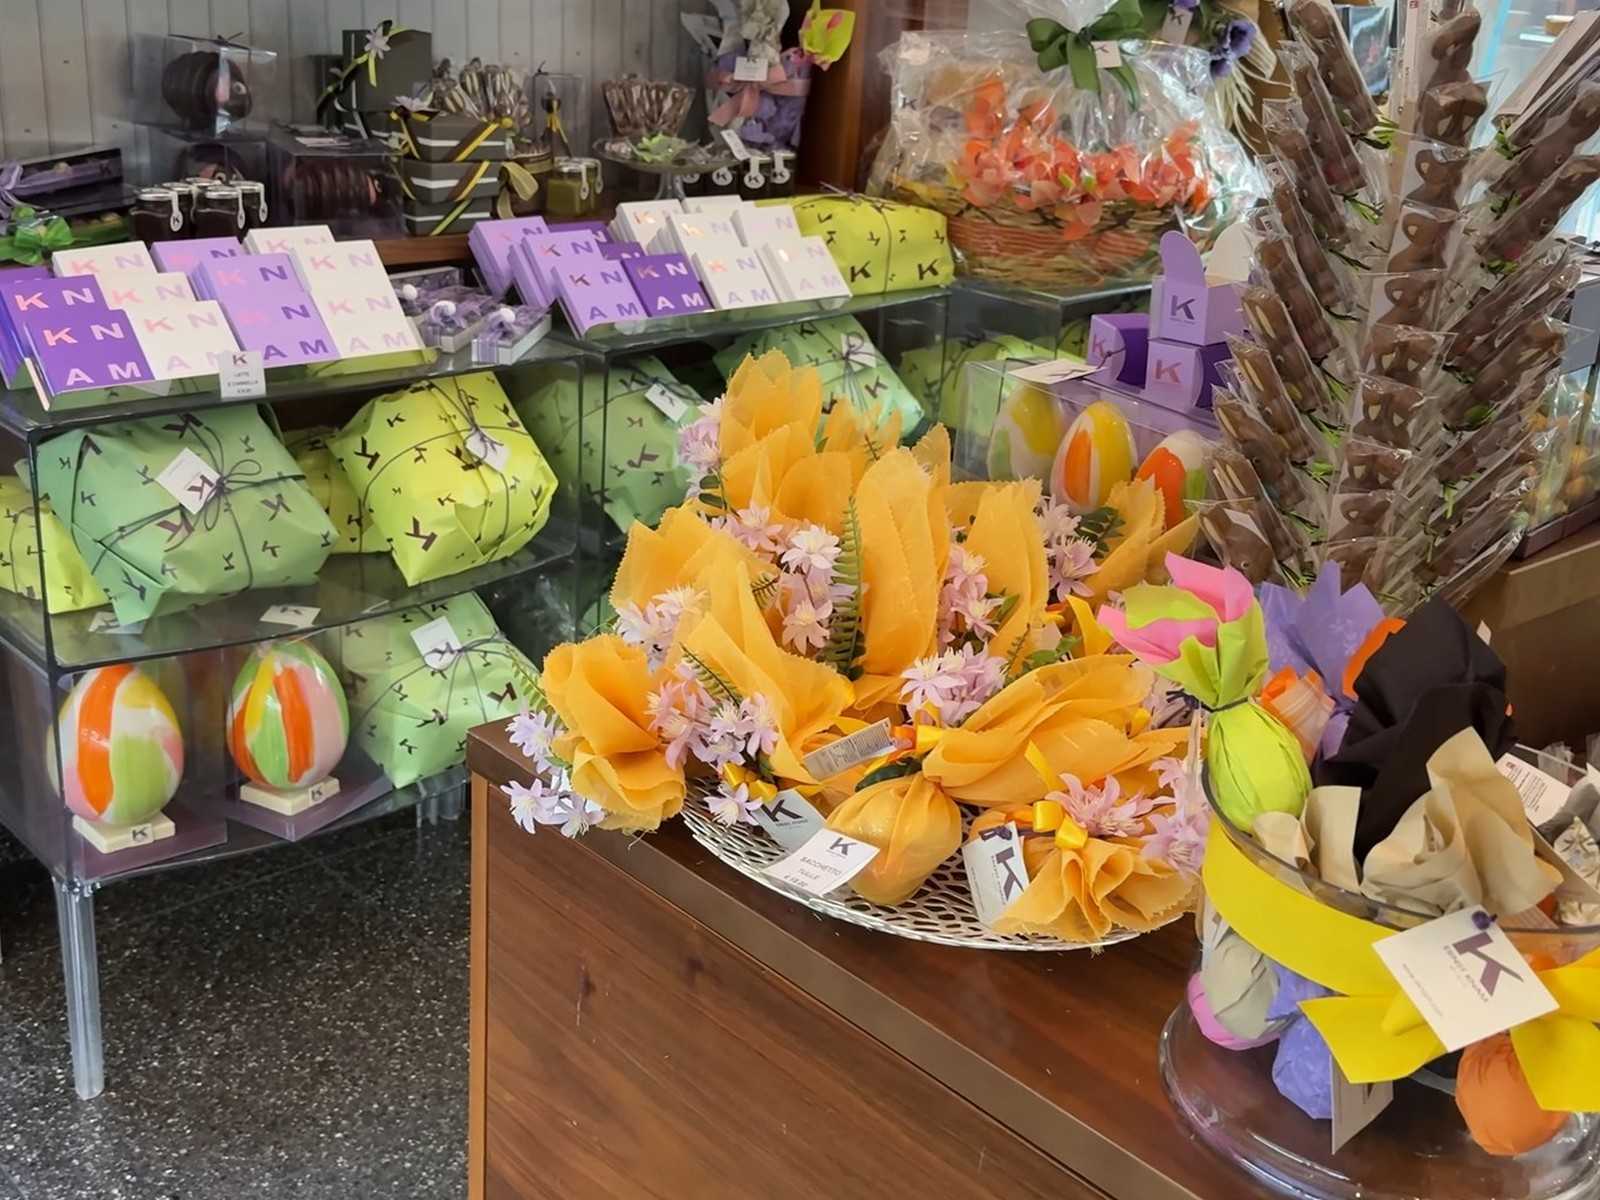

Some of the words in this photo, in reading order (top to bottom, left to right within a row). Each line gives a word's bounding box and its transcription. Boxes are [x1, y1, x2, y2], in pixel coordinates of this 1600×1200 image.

[902, 97, 918, 111] K
[851, 260, 872, 283] K
[917, 258, 940, 281] K
[1171, 295, 1196, 320] K
[232, 354, 248, 366] K
[1155, 359, 1183, 384] K
[865, 375, 889, 398] K
[386, 412, 406, 428] K
[354, 436, 381, 471] K
[81, 491, 96, 507] K
[405, 516, 439, 552] K
[261, 540, 281, 559] K
[222, 551, 236, 572] K
[488, 682, 518, 711] K
[311, 785, 324, 800] K
[761, 799, 804, 823] K
[132, 825, 148, 840] K
[830, 837, 858, 857] K
[996, 846, 1025, 902] K
[1452, 931, 1525, 998] K
